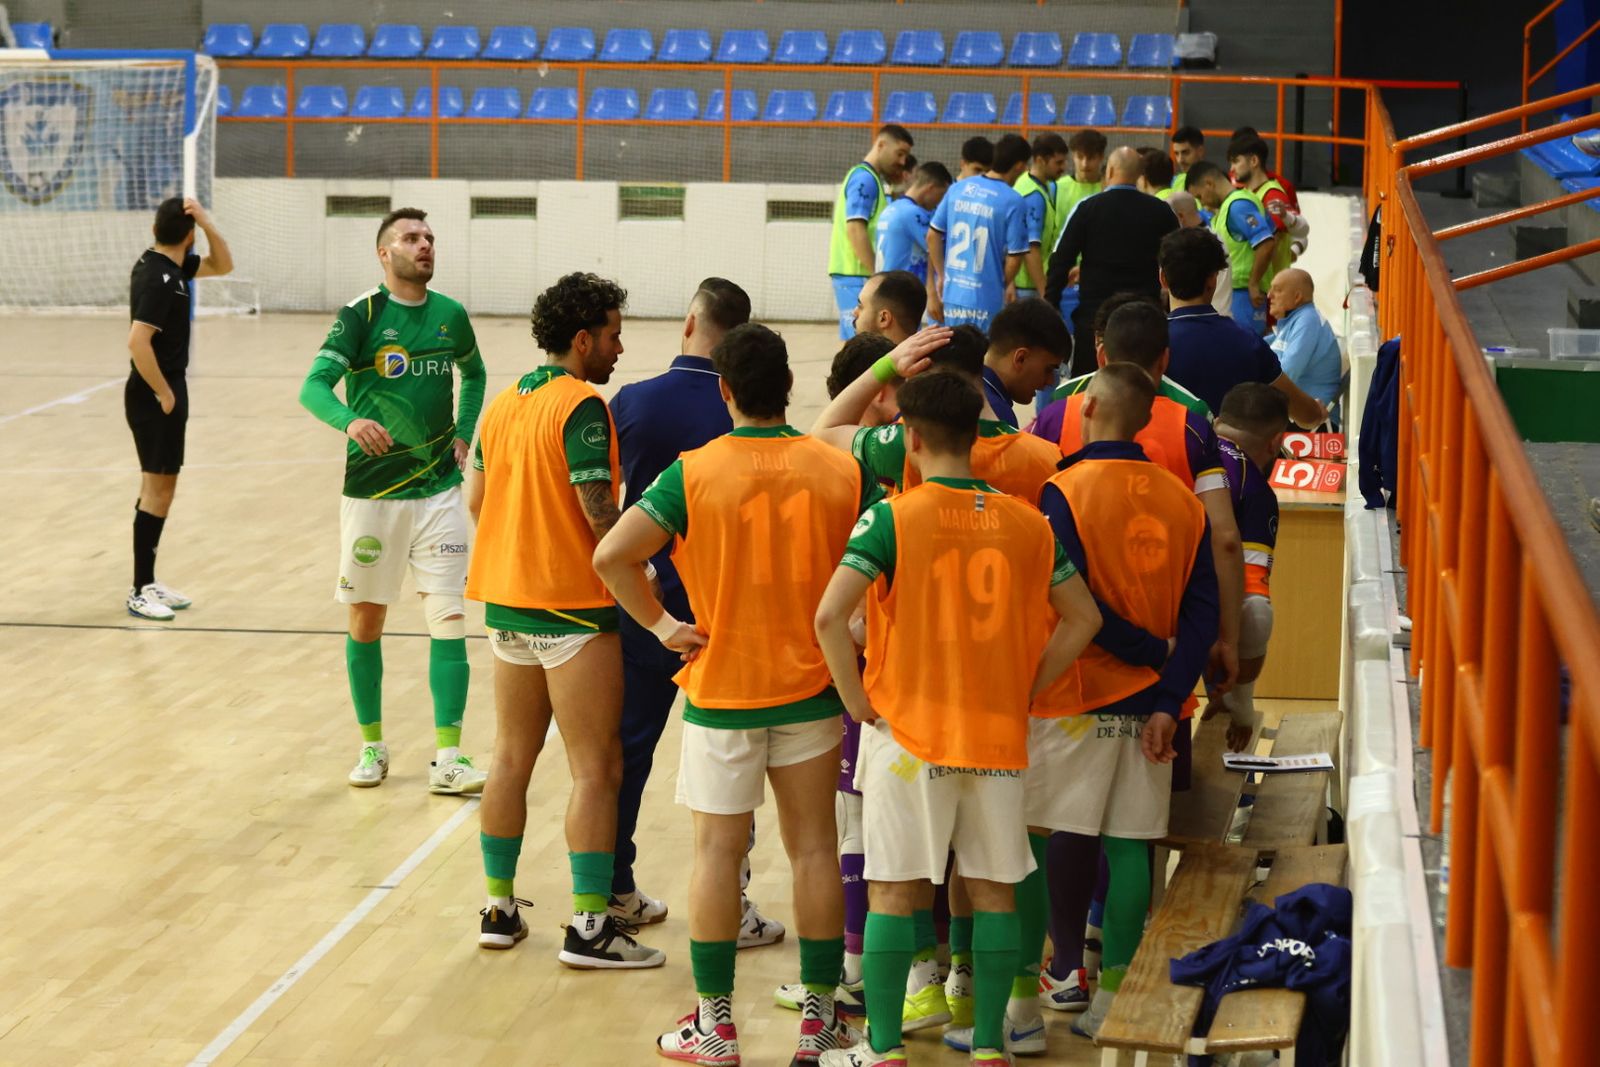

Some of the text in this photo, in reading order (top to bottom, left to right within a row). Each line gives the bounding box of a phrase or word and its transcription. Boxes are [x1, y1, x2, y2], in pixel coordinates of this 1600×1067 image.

[946, 220, 989, 274] 21
[1126, 474, 1151, 496] 12
[739, 488, 812, 585] 11
[938, 507, 1000, 530] MARCOS
[932, 547, 1011, 641] 19
[1096, 727, 1115, 738] DE
